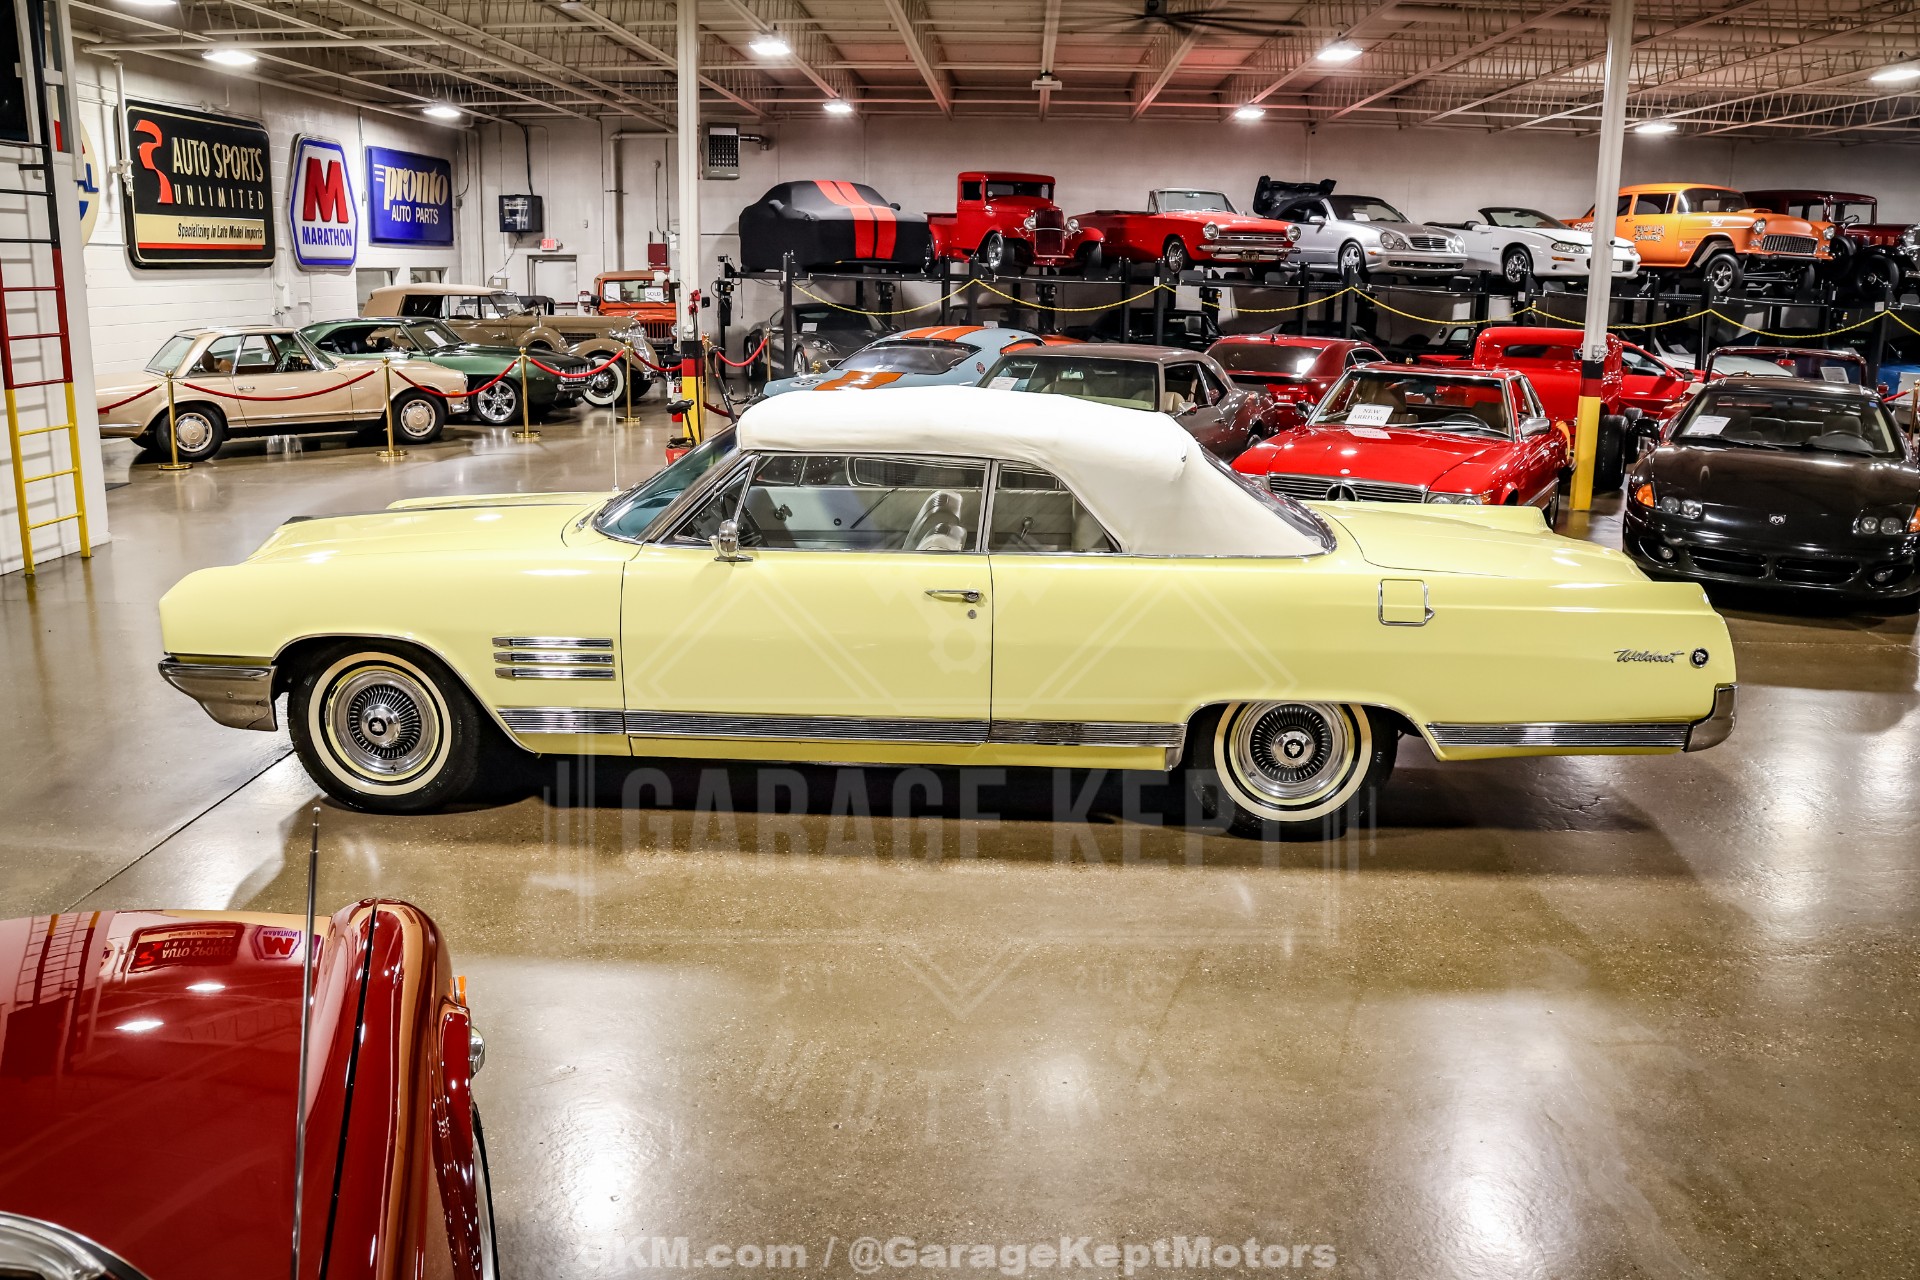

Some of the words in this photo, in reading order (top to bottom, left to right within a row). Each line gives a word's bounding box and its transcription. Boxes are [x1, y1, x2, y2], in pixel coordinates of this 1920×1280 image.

[172, 137, 211, 178] AUTO
[212, 142, 265, 183] SPORTS
[173, 184, 264, 210] UNLIMITED
[303, 156, 349, 224] M
[383, 165, 449, 211] pronto
[391, 205, 411, 223] AUTO
[415, 207, 439, 225] PARTS
[178, 222, 210, 240] Specializing
[217, 224, 228, 238] Late
[228, 225, 244, 239] Model
[302, 226, 353, 247] MARATHON
[1613, 649, 1685, 664] Wildcat
